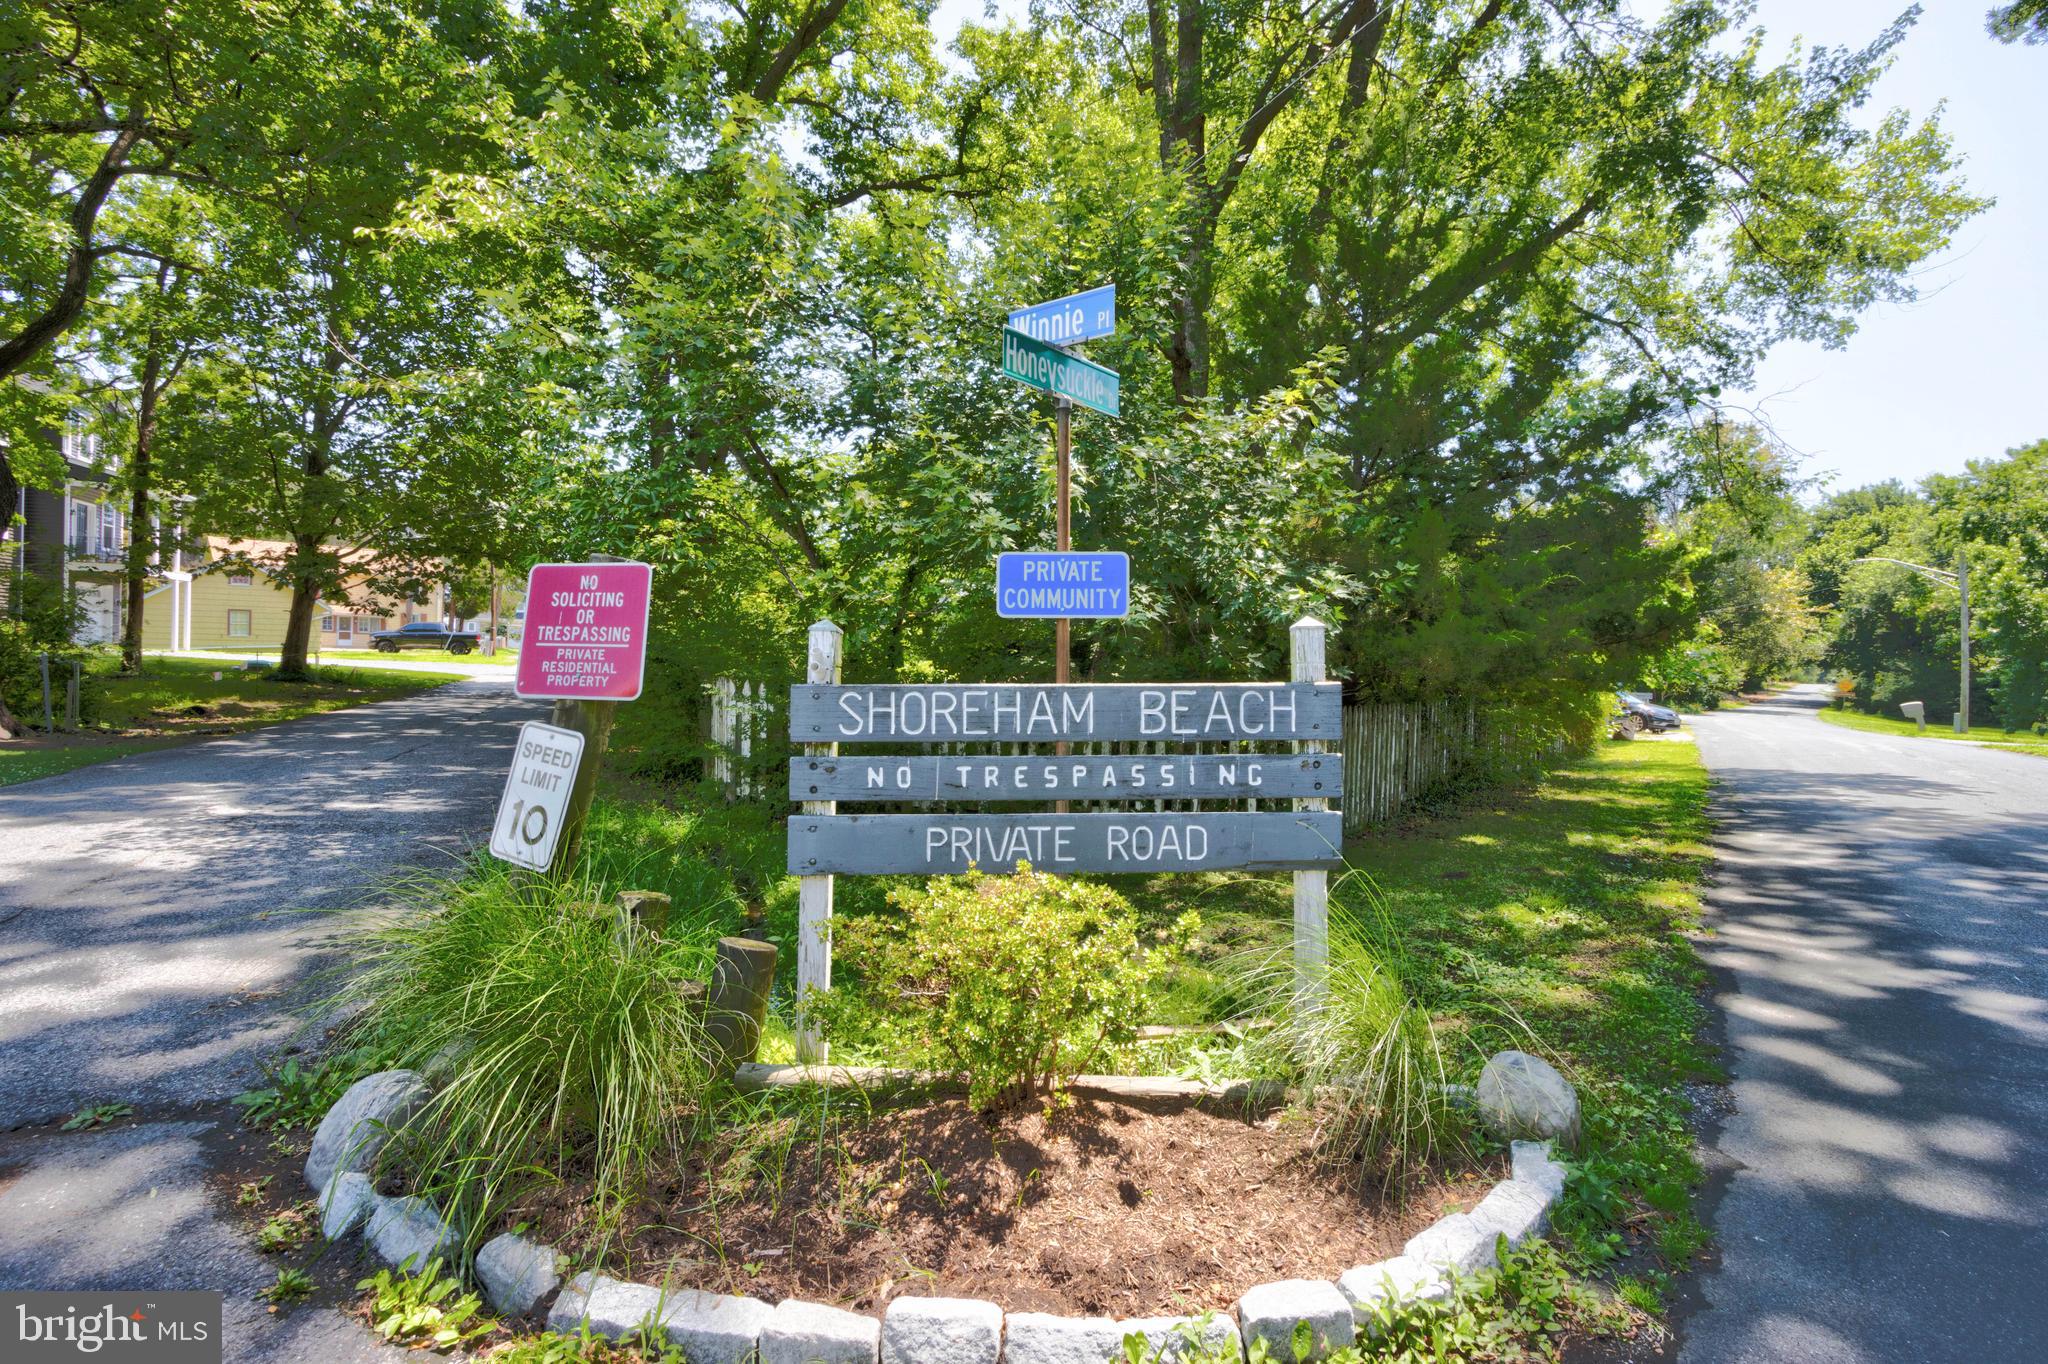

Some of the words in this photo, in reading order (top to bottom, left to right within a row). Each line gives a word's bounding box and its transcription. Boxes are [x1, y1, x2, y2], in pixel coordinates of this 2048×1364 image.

[1014, 303, 1084, 340] Winnie
[1097, 310, 1110, 330] Pl
[1006, 334, 1105, 404] Honeysuckle
[1023, 560, 1103, 582] PRIVATE
[580, 575, 598, 590] NO
[551, 591, 624, 607] SOLICITING
[1004, 588, 1121, 609] COMMUNITY
[576, 609, 595, 624] OR
[537, 626, 631, 642] TRESPASSING
[556, 648, 605, 661] PRIVATE
[541, 661, 616, 674] RESIDENTIAL
[546, 674, 609, 688] PROPERTY
[838, 691, 1094, 735] SHOREHAM
[1139, 690, 1296, 734] BEACH
[522, 741, 573, 769] SPEED
[520, 767, 562, 792] LIMIT
[867, 767, 911, 788] NO
[956, 764, 1262, 788] TRESPASSING
[509, 799, 548, 846] 10
[926, 825, 1076, 862] PRIVATE
[1107, 825, 1208, 860] ROAD
